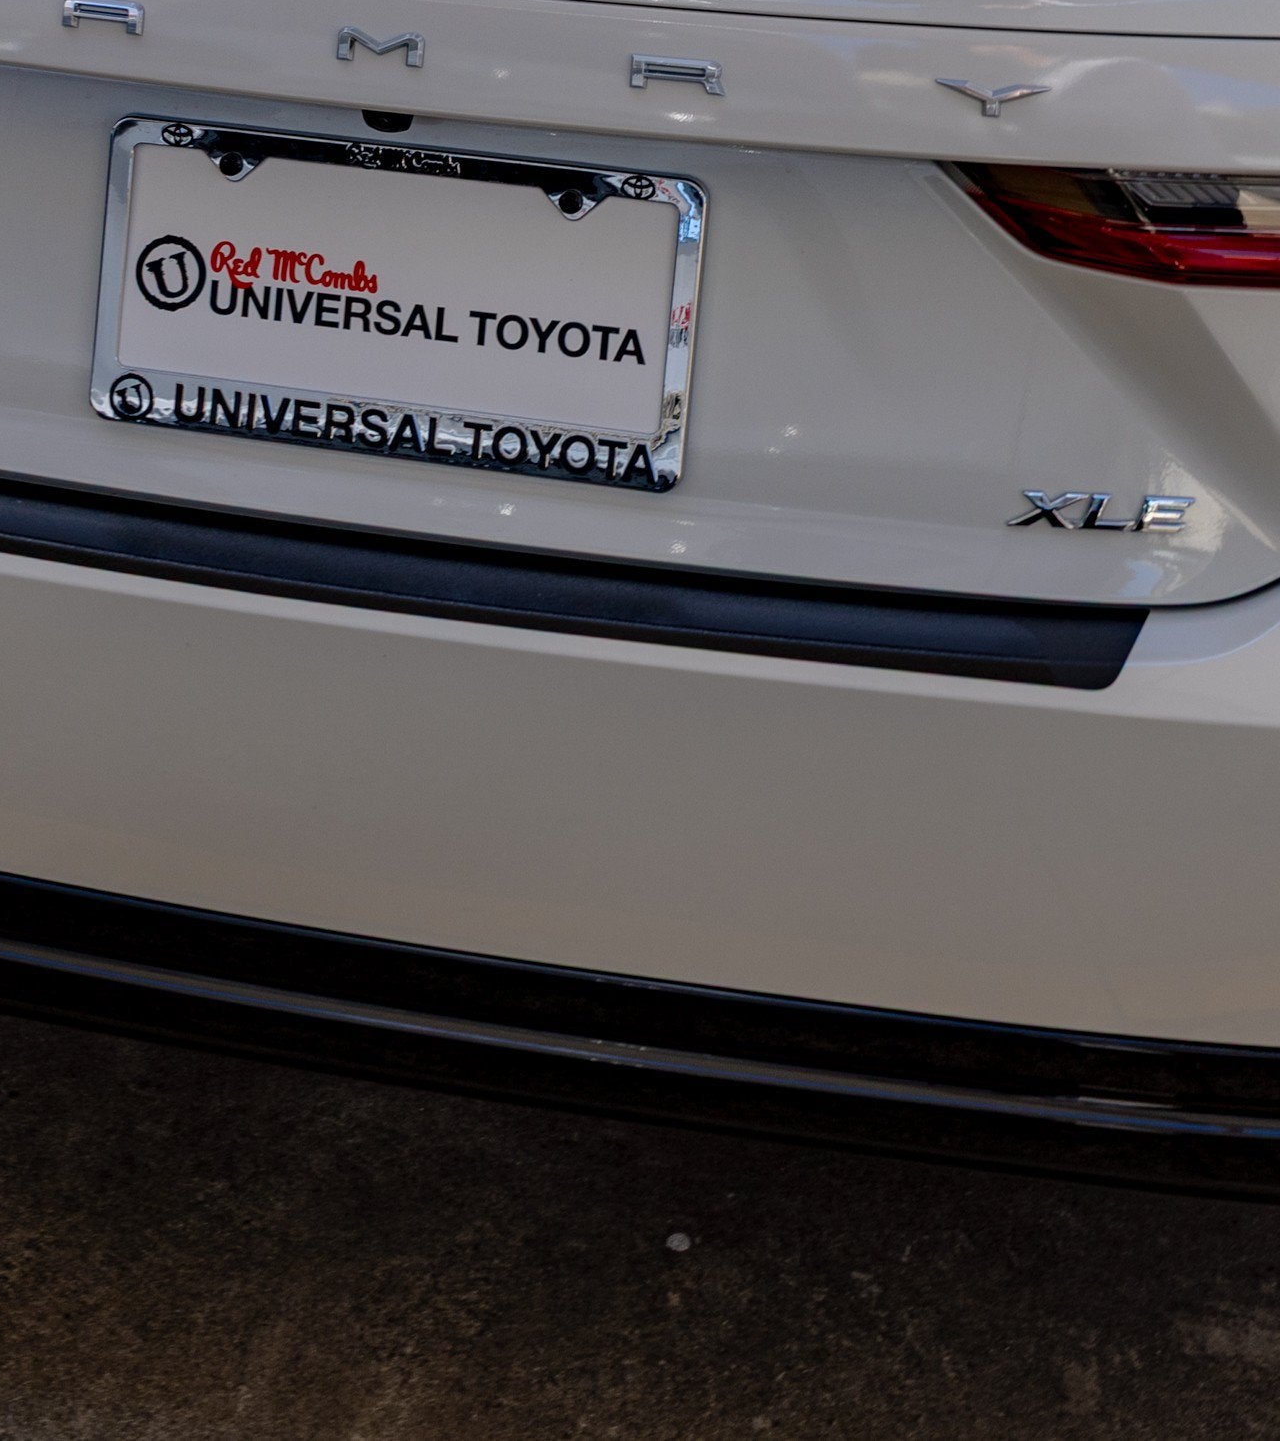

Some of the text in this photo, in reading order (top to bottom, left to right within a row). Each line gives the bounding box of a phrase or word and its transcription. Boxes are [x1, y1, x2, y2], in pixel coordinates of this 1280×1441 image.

[210, 241, 378, 294] Red McCombs
[209, 279, 646, 365] UNIVERSAL TOYOTA
[173, 382, 455, 456] UNIVERSAL
[463, 420, 659, 484] TOYOTA
[1006, 489, 1197, 533] XLE
